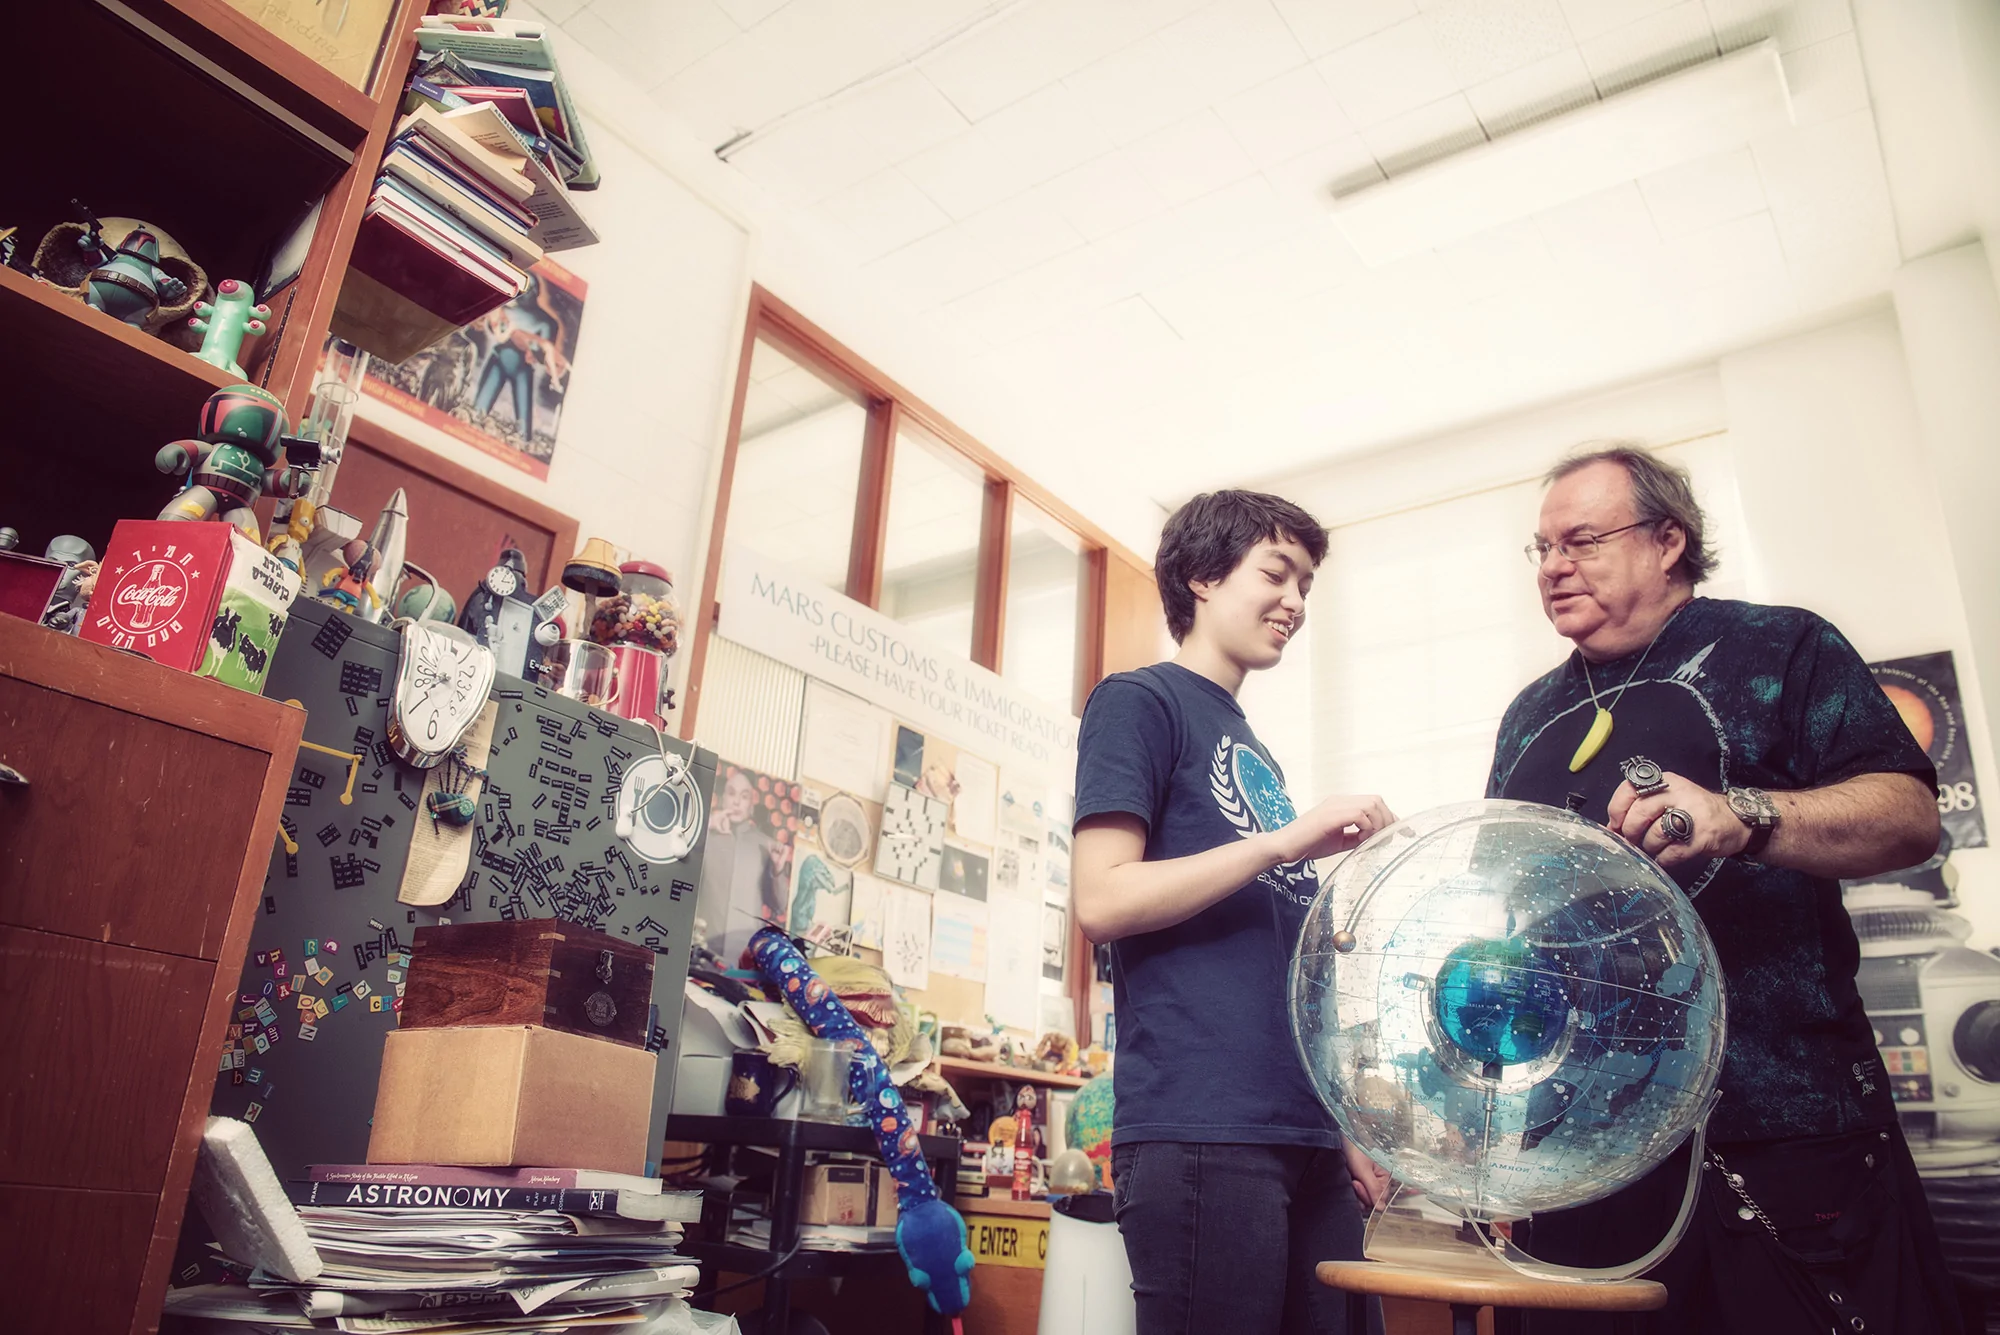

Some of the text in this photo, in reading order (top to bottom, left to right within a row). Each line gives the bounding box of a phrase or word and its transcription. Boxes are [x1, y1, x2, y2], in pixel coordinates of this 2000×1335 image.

[750, 572, 824, 626] MARS
[830, 611, 938, 683] CUSTOMS
[944, 668, 958, 693] &
[875, 664, 916, 698] HAVE
[919, 684, 962, 723] YOUR
[967, 709, 1009, 741] TICKET
[1010, 730, 1054, 762] READY
[310, 1181, 319, 1203] FRANK
[346, 1184, 511, 1208] ASTRONOMY
[558, 1188, 566, 1211] COSMOS
[979, 1225, 1018, 1257] ENTER
